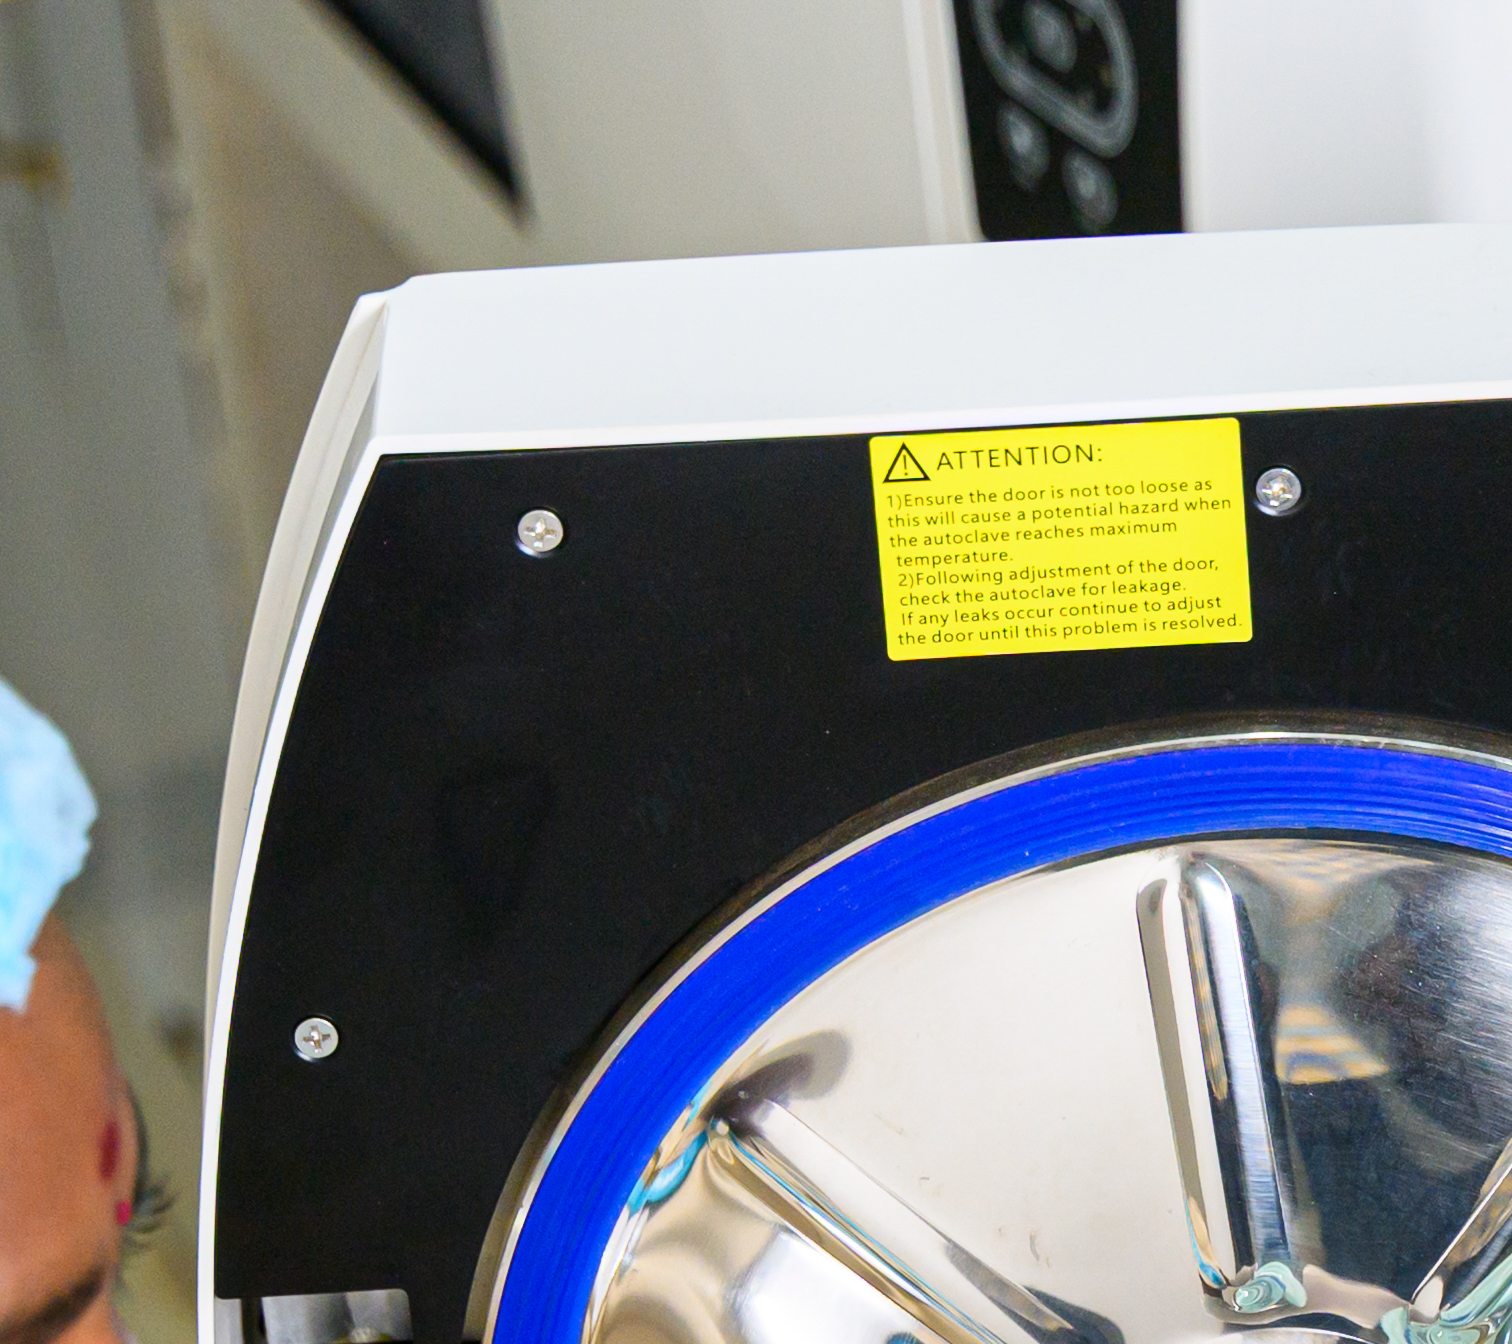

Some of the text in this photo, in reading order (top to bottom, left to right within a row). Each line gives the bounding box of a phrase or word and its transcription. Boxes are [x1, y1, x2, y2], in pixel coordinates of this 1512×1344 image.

[936, 444, 1102, 471] ATTENTION:
[969, 490, 997, 503] the
[1003, 488, 1045, 501] door
[1051, 489, 1064, 498] is
[1070, 485, 1100, 497] not
[1105, 484, 1135, 496] too
[1141, 481, 1188, 493] loose
[1194, 480, 1212, 491] as
[888, 497, 1231, 528] this will cause a potential hazard when
[889, 522, 1177, 548] the autoclave reaches maximum
[896, 551, 1013, 569] temperature.
[1009, 564, 1111, 583] adjustment
[1116, 560, 1133, 574] of
[1139, 560, 1167, 573] the
[1173, 558, 1218, 571] door,
[900, 580, 1186, 606] check the autoclave for leakage.
[902, 597, 1221, 627] If any leaks occur continue to adjust
[898, 613, 1242, 645] the door until this problem is resolved.
